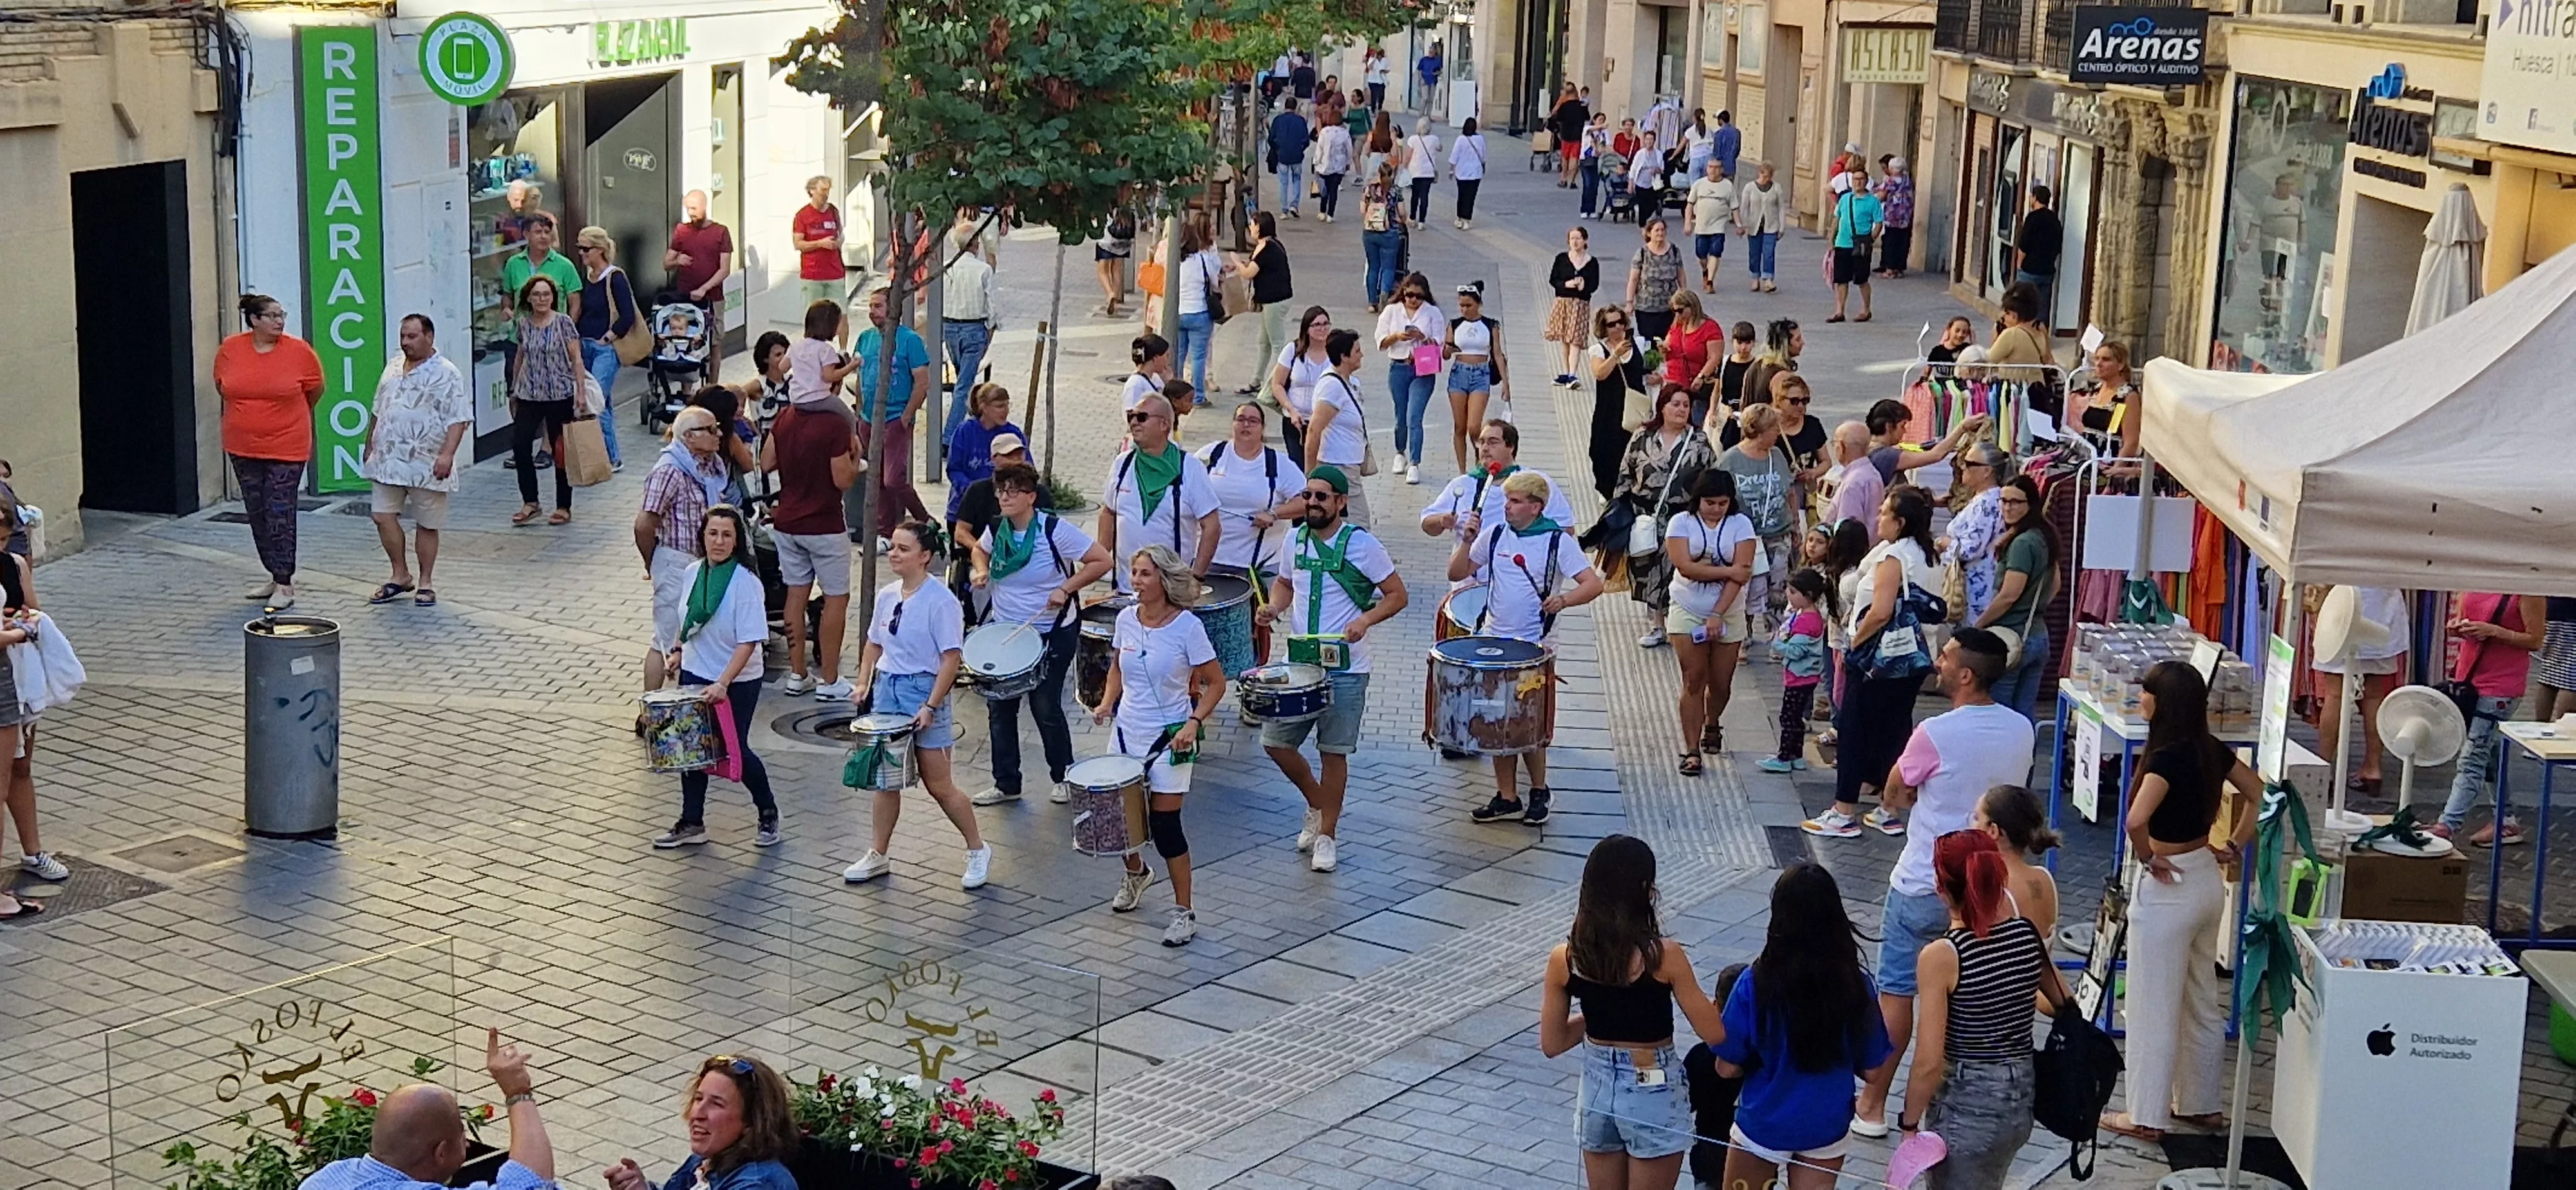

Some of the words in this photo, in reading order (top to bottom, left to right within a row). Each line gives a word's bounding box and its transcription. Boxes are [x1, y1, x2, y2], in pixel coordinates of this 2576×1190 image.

[439, 22, 488, 41] PLAZA
[1850, 30, 1927, 71] ASCASO
[2078, 28, 2201, 61] Arenas
[2078, 62, 2113, 73] CENTRO
[2115, 61, 2148, 74] ÓPTICO
[2149, 64, 2155, 73] Y
[2157, 64, 2199, 75] AUDITIVO
[2512, 48, 2554, 75] Huesca
[443, 80, 486, 95] MOVIL
[2349, 88, 2432, 156] Arenas
[323, 41, 369, 480] REPARACION
[2411, 1033, 2479, 1046] Distribuidor
[2409, 1048, 2472, 1061] Autorizado
